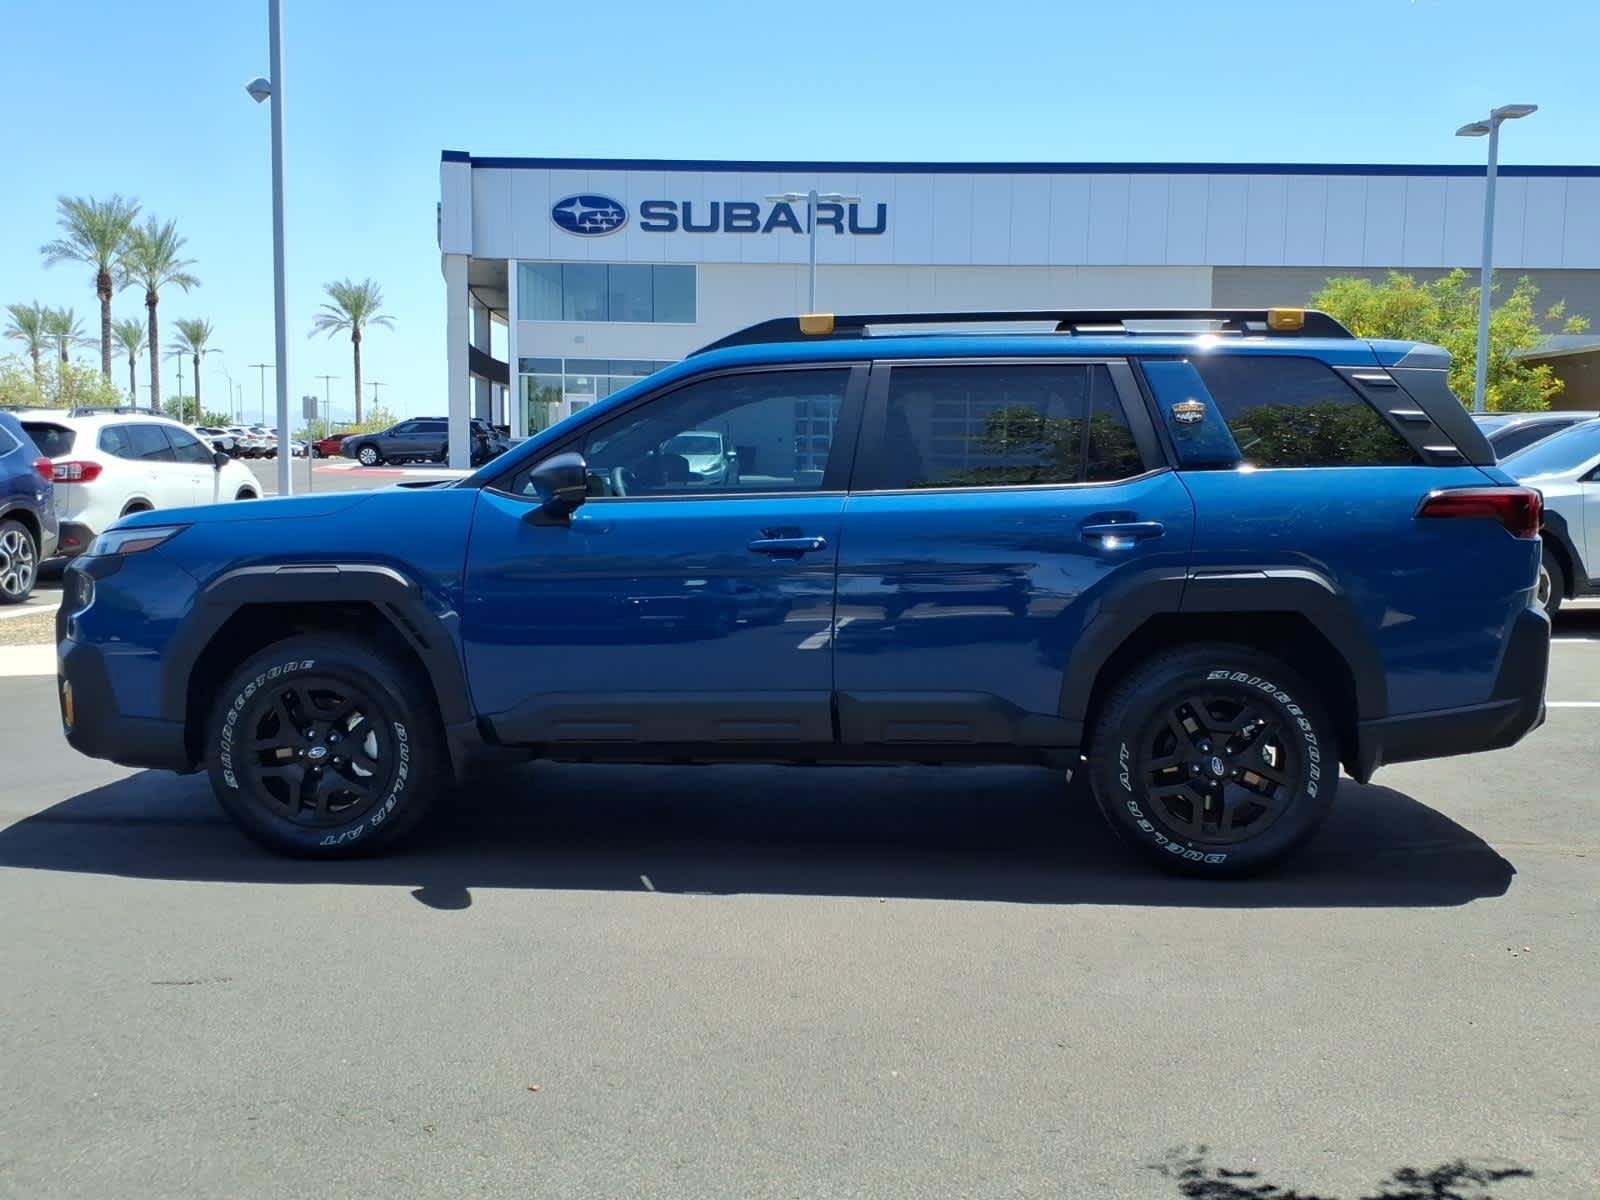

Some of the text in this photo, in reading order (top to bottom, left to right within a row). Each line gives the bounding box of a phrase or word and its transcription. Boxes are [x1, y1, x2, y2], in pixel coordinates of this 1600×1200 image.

[639, 200, 887, 235] SUBARU
[220, 659, 316, 789] BRIDGESTONE
[319, 721, 410, 845] DUELER A/T
[1206, 670, 1321, 798] BRIDGESTONE
[1119, 742, 1227, 863] DUELER A/T
